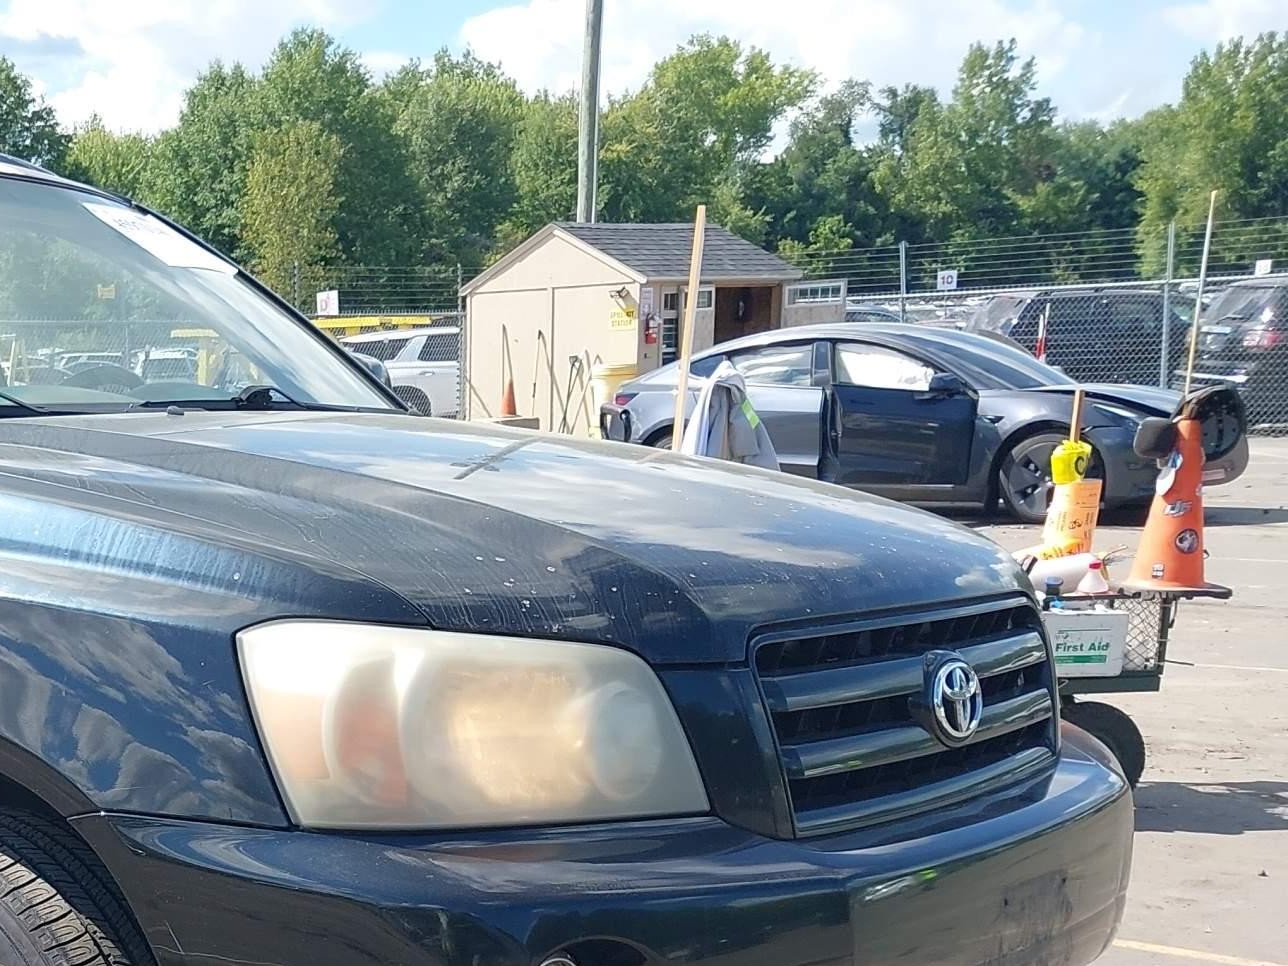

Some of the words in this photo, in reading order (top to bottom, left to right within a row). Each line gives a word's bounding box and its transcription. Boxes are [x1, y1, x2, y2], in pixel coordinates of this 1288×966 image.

[941, 275, 953, 285] 10
[1055, 642, 1084, 653] First
[1088, 641, 1110, 652] Aid
